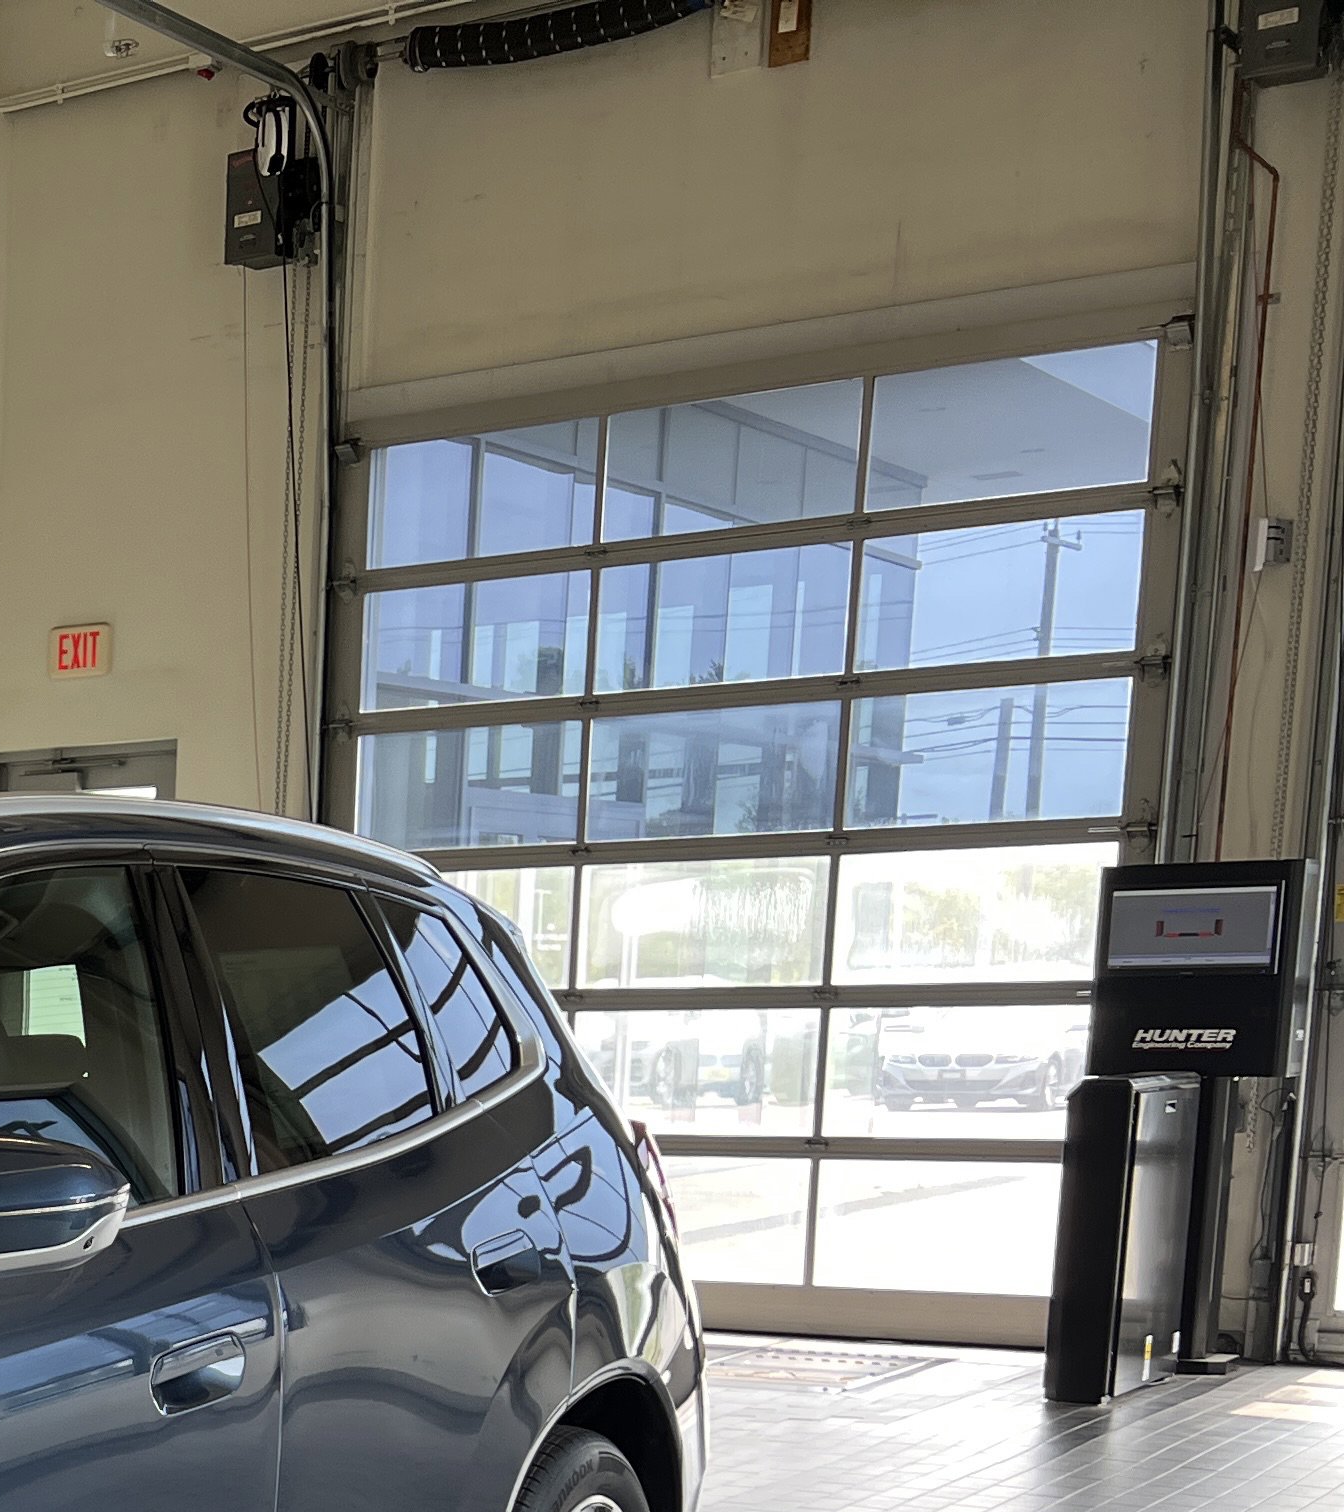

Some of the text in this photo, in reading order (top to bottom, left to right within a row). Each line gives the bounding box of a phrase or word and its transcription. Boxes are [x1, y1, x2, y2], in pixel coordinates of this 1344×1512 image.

[58, 630, 100, 670] EXIT
[1134, 1029, 1237, 1042] HUNTER
[1132, 1041, 1232, 1050] Engineering Company
